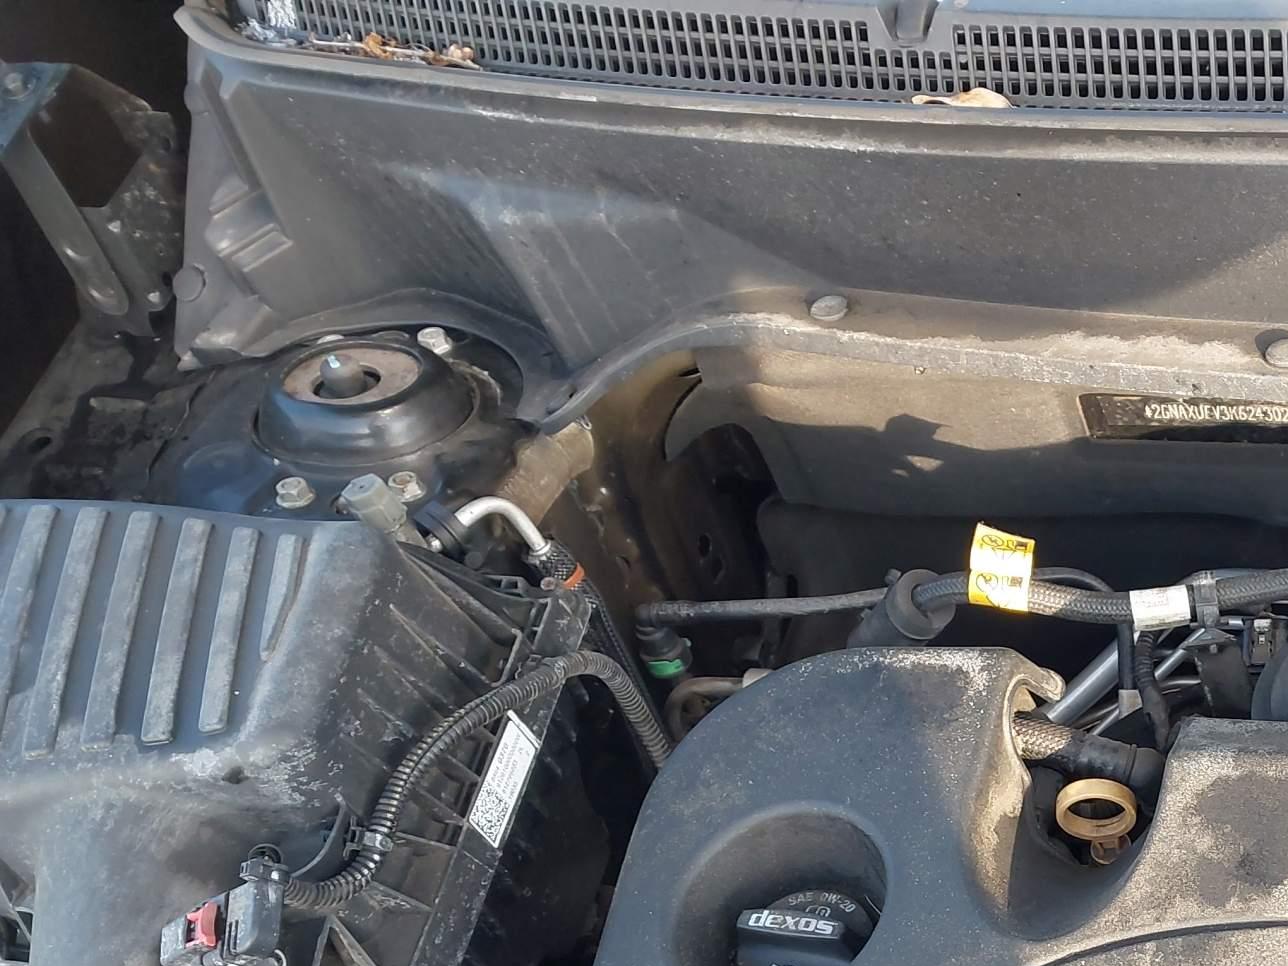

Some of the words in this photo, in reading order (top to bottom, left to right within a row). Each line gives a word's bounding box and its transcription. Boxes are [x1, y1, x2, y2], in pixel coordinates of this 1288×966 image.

[788, 892, 815, 906] SAE
[820, 892, 856, 913] 0W-20
[748, 910, 839, 935] dexos
